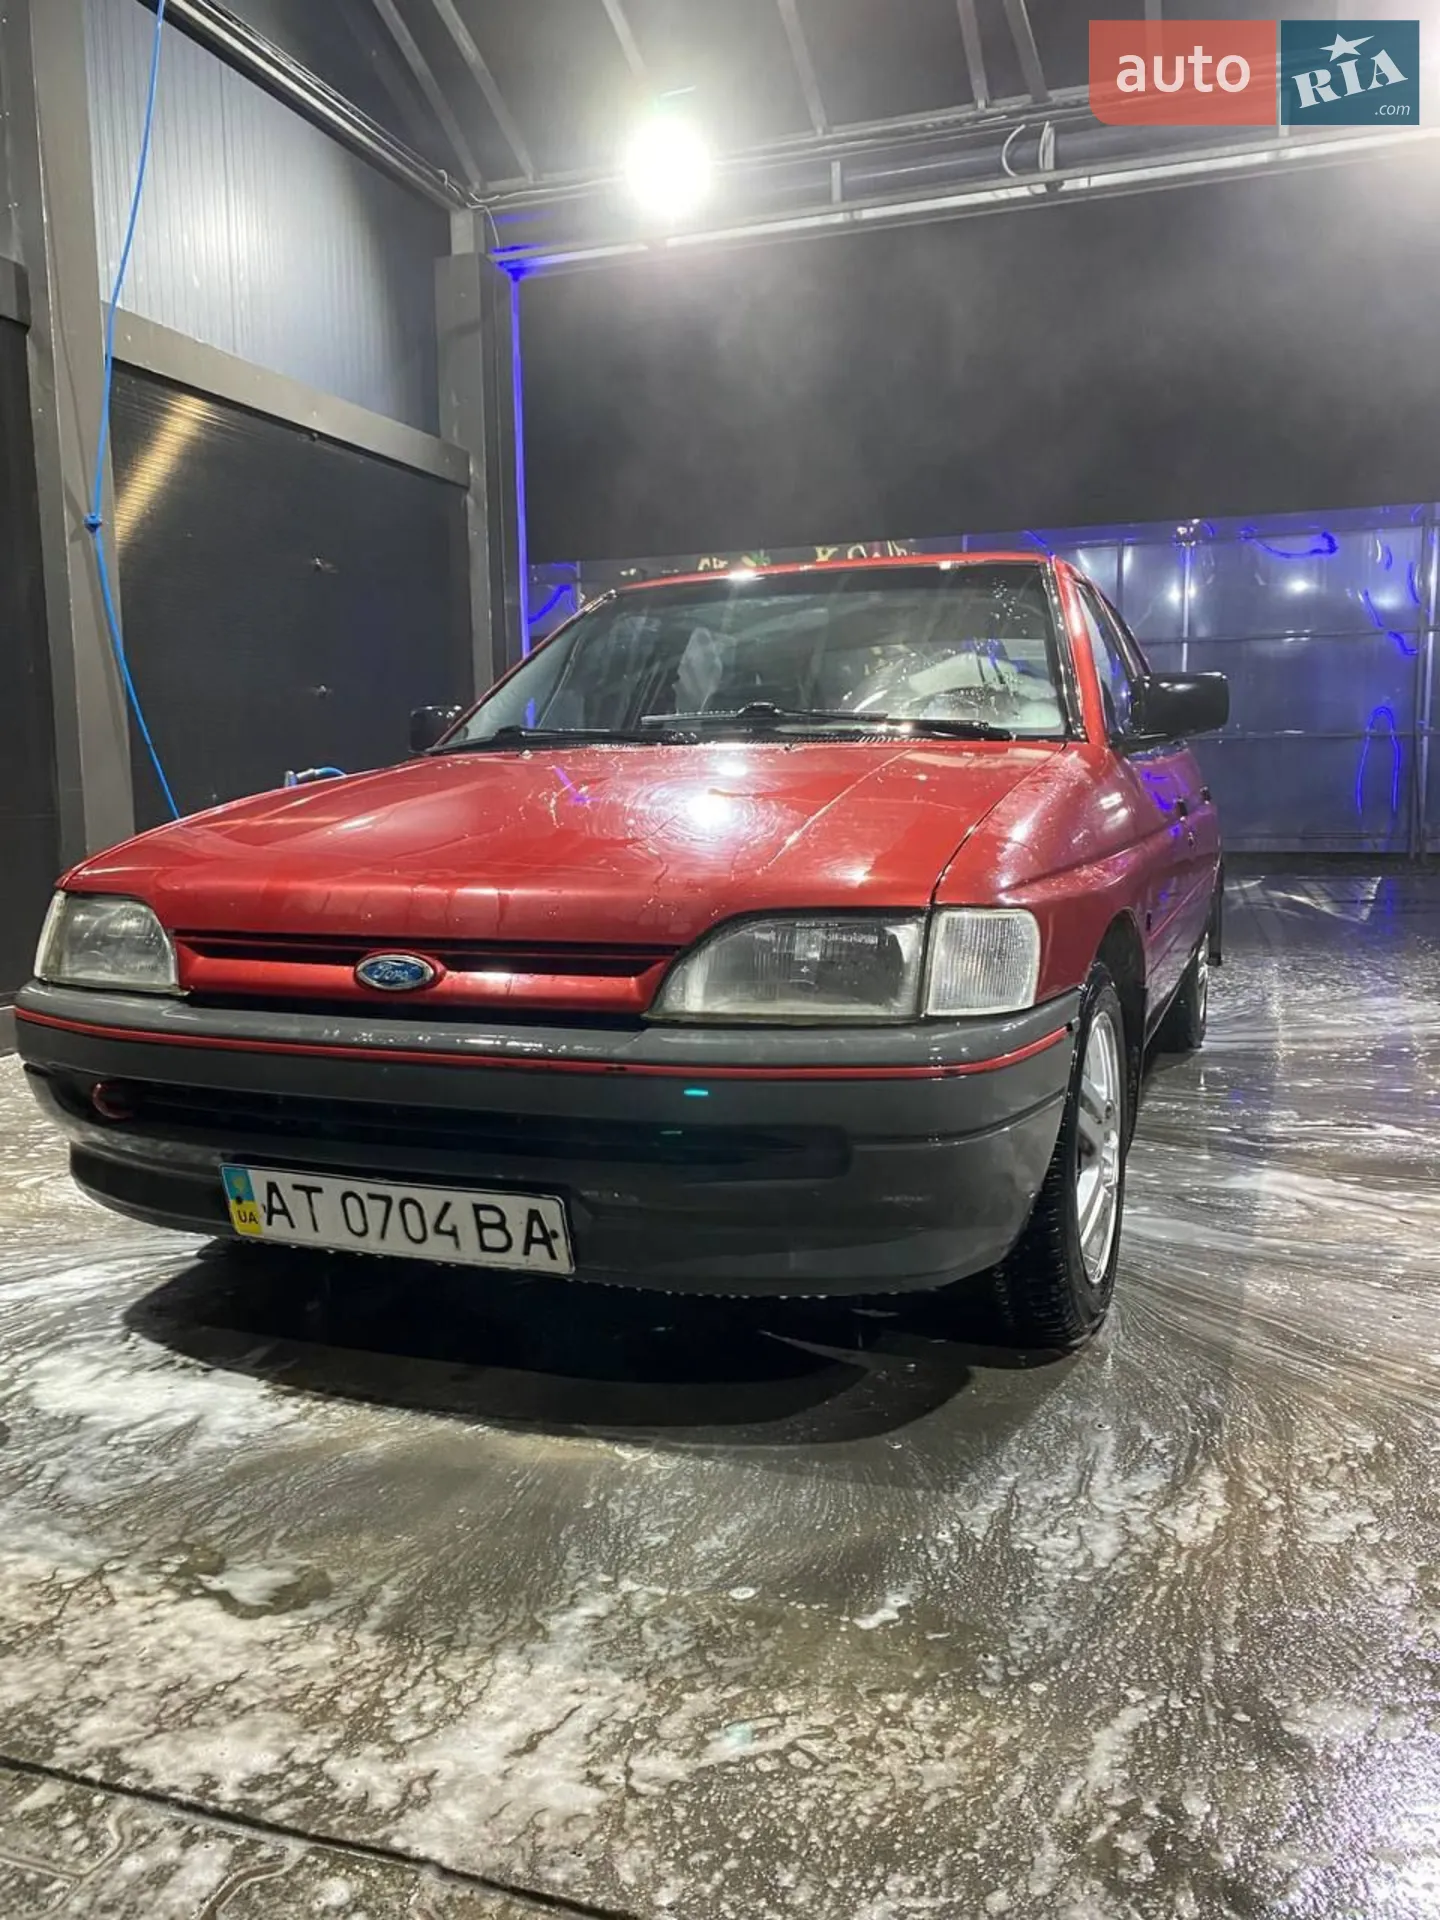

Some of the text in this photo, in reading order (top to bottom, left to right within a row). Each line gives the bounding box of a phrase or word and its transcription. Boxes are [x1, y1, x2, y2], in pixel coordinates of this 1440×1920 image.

[237, 1210, 259, 1224] UA
[266, 1181, 559, 1261] AT 0704 BA
